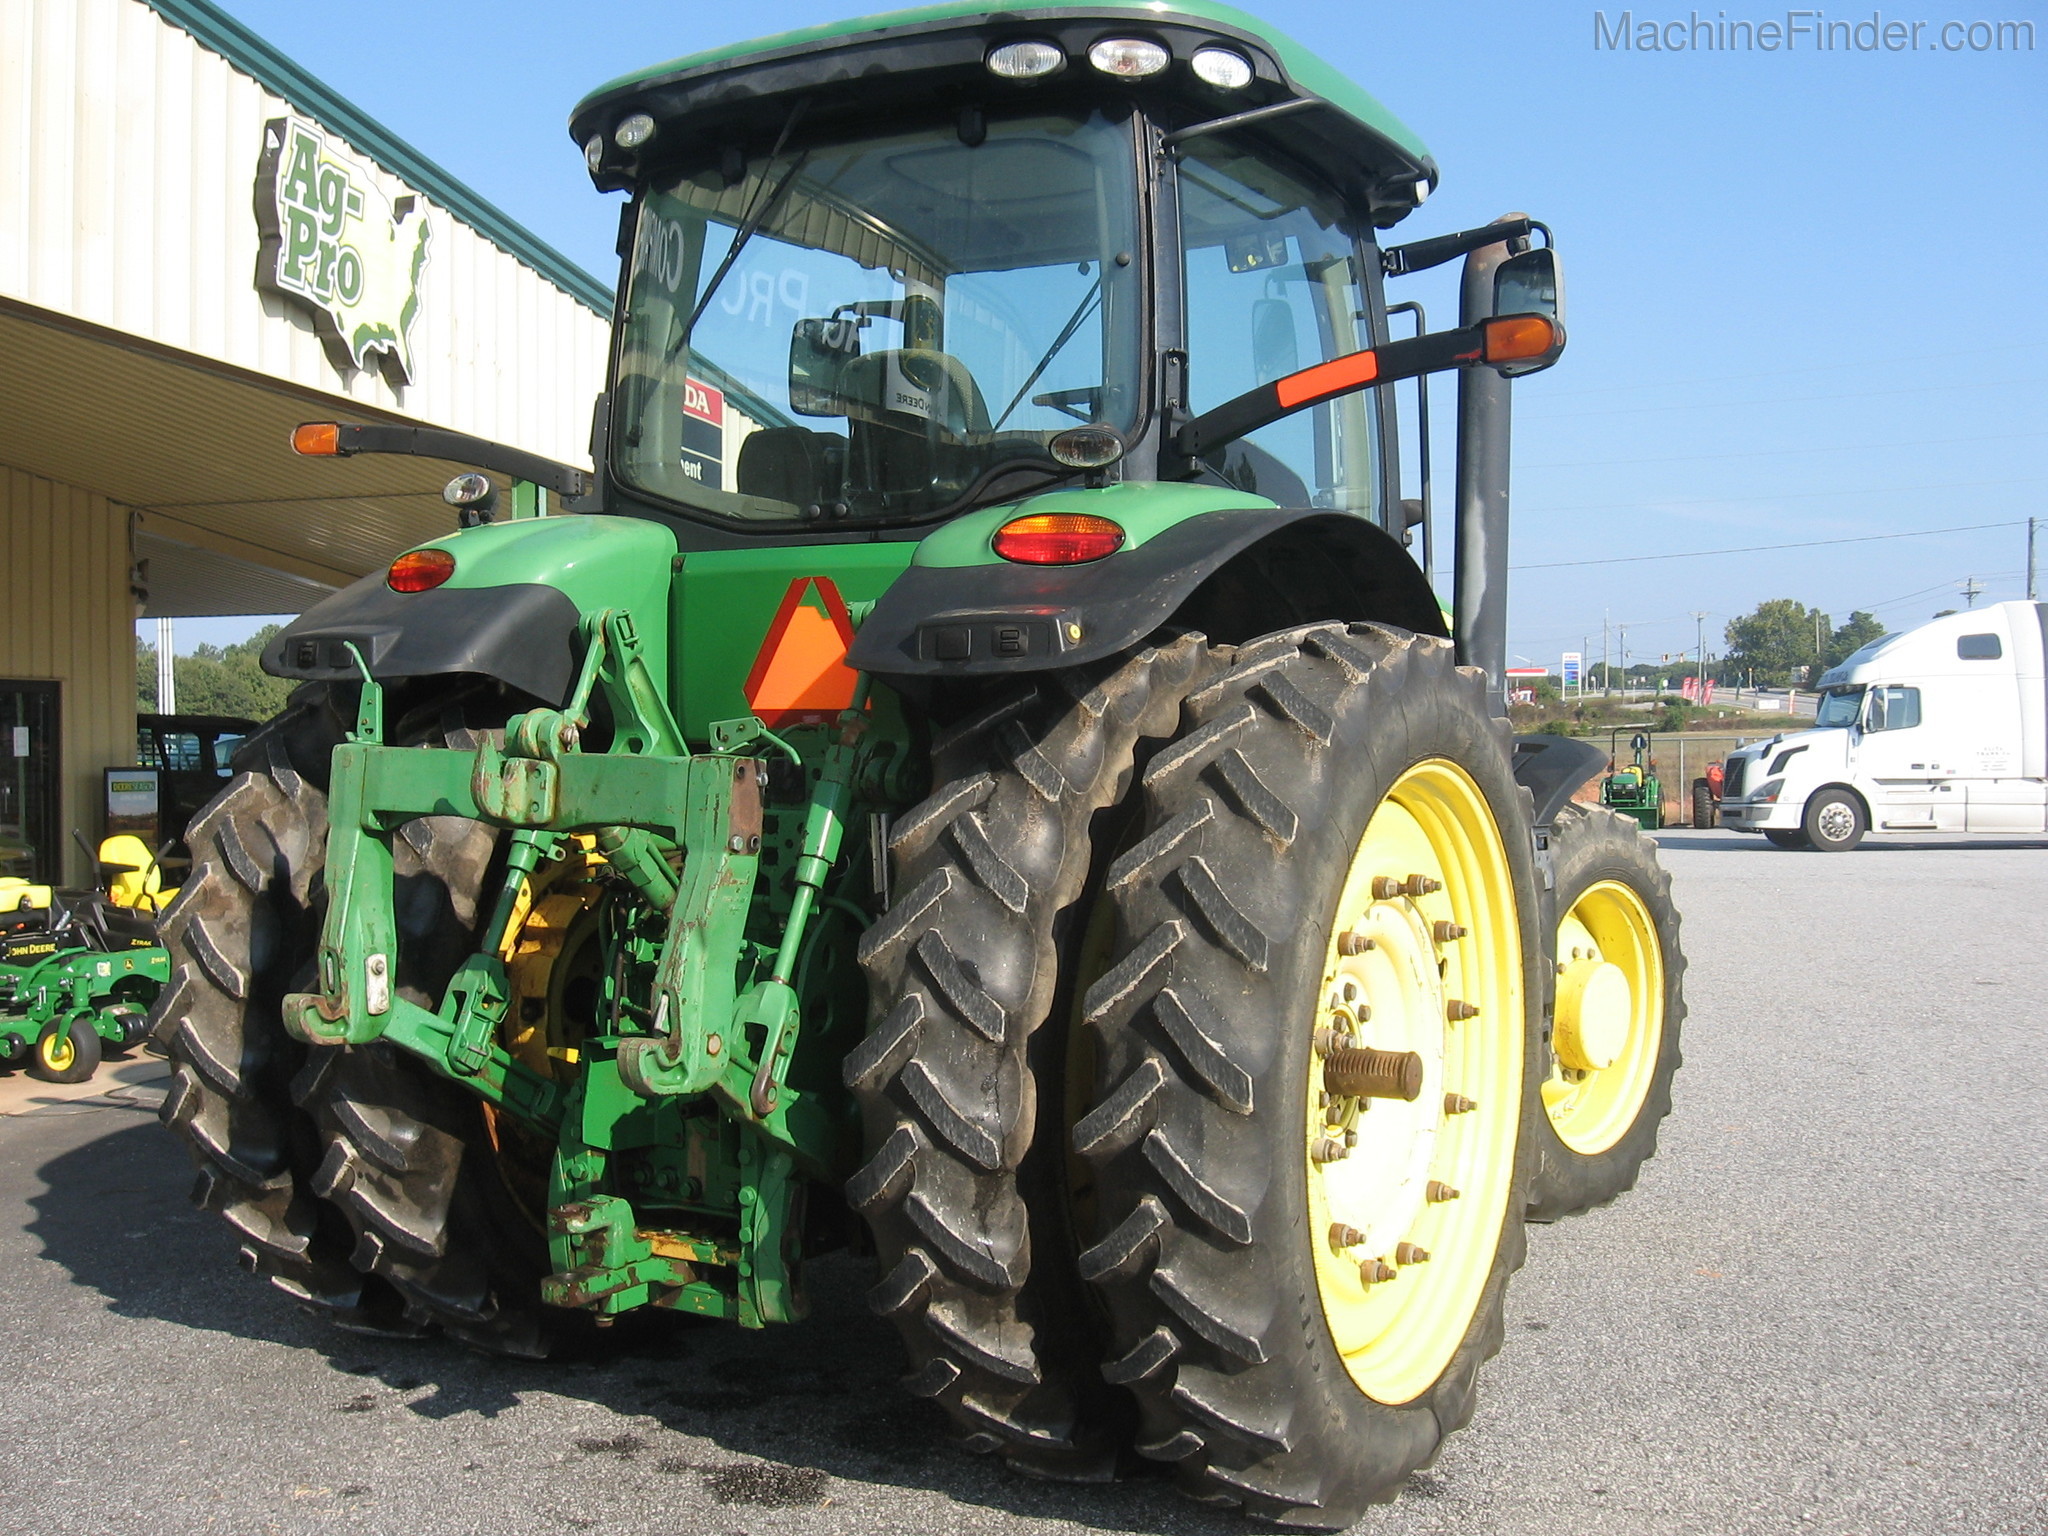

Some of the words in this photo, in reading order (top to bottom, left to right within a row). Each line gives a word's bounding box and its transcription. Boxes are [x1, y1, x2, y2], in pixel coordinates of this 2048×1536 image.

[284, 132, 361, 237] Ag-
[283, 204, 361, 300] Pro
[29, 943, 56, 955] DEERE
